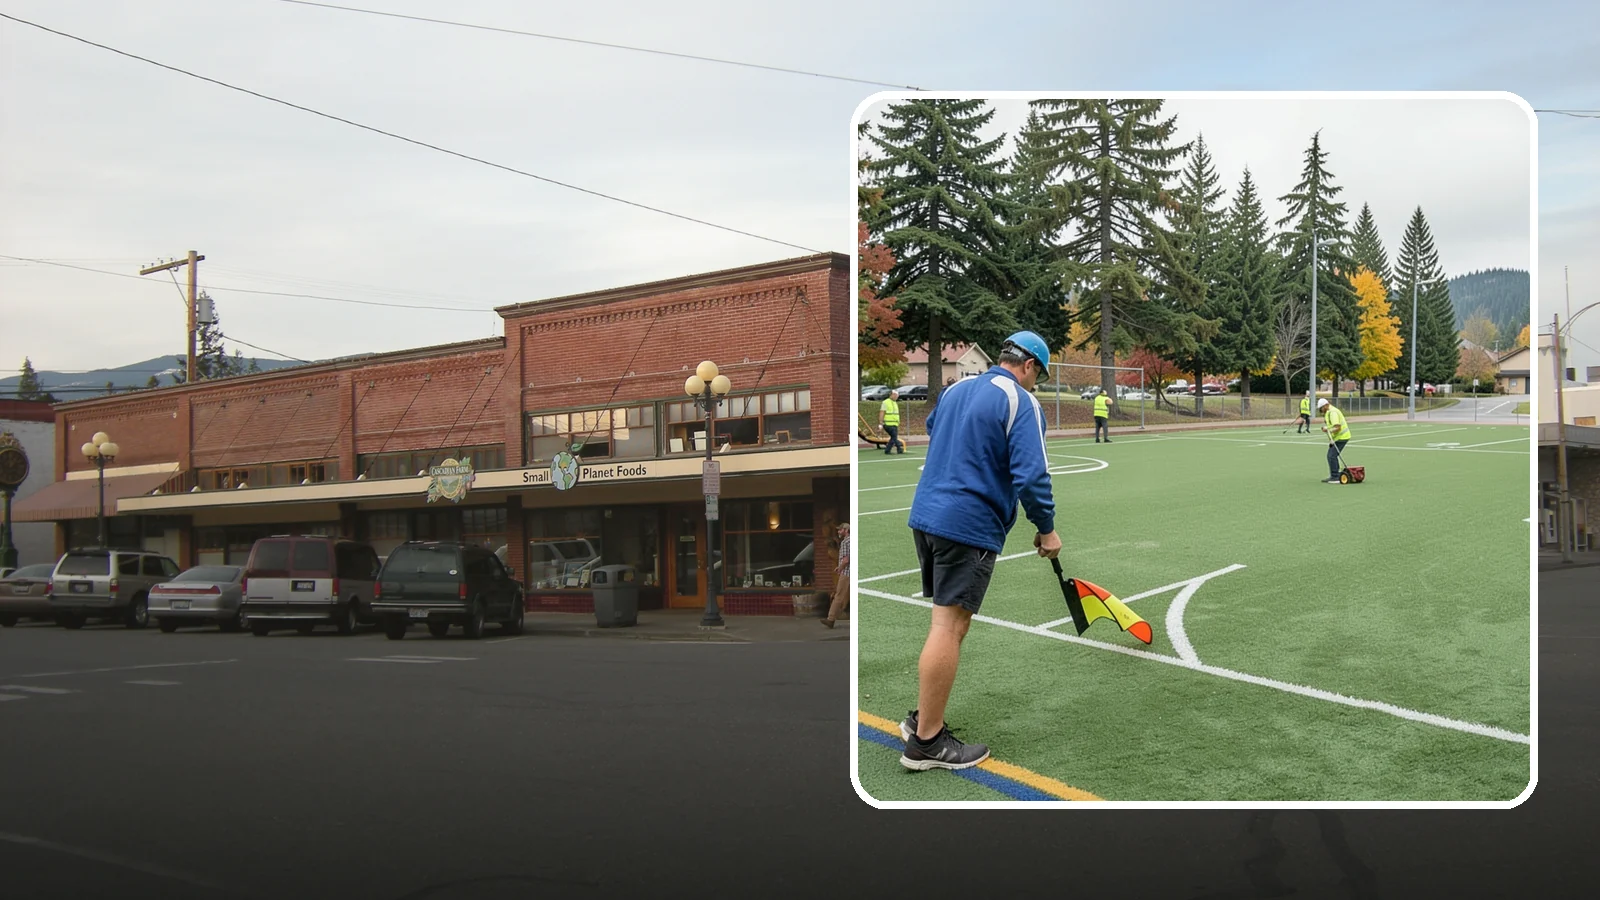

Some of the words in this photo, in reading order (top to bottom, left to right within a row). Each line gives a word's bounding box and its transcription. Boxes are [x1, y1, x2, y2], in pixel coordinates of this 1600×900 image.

[522, 471, 549, 483] Small
[582, 467, 614, 479] Planet
[616, 464, 647, 477] Foods
